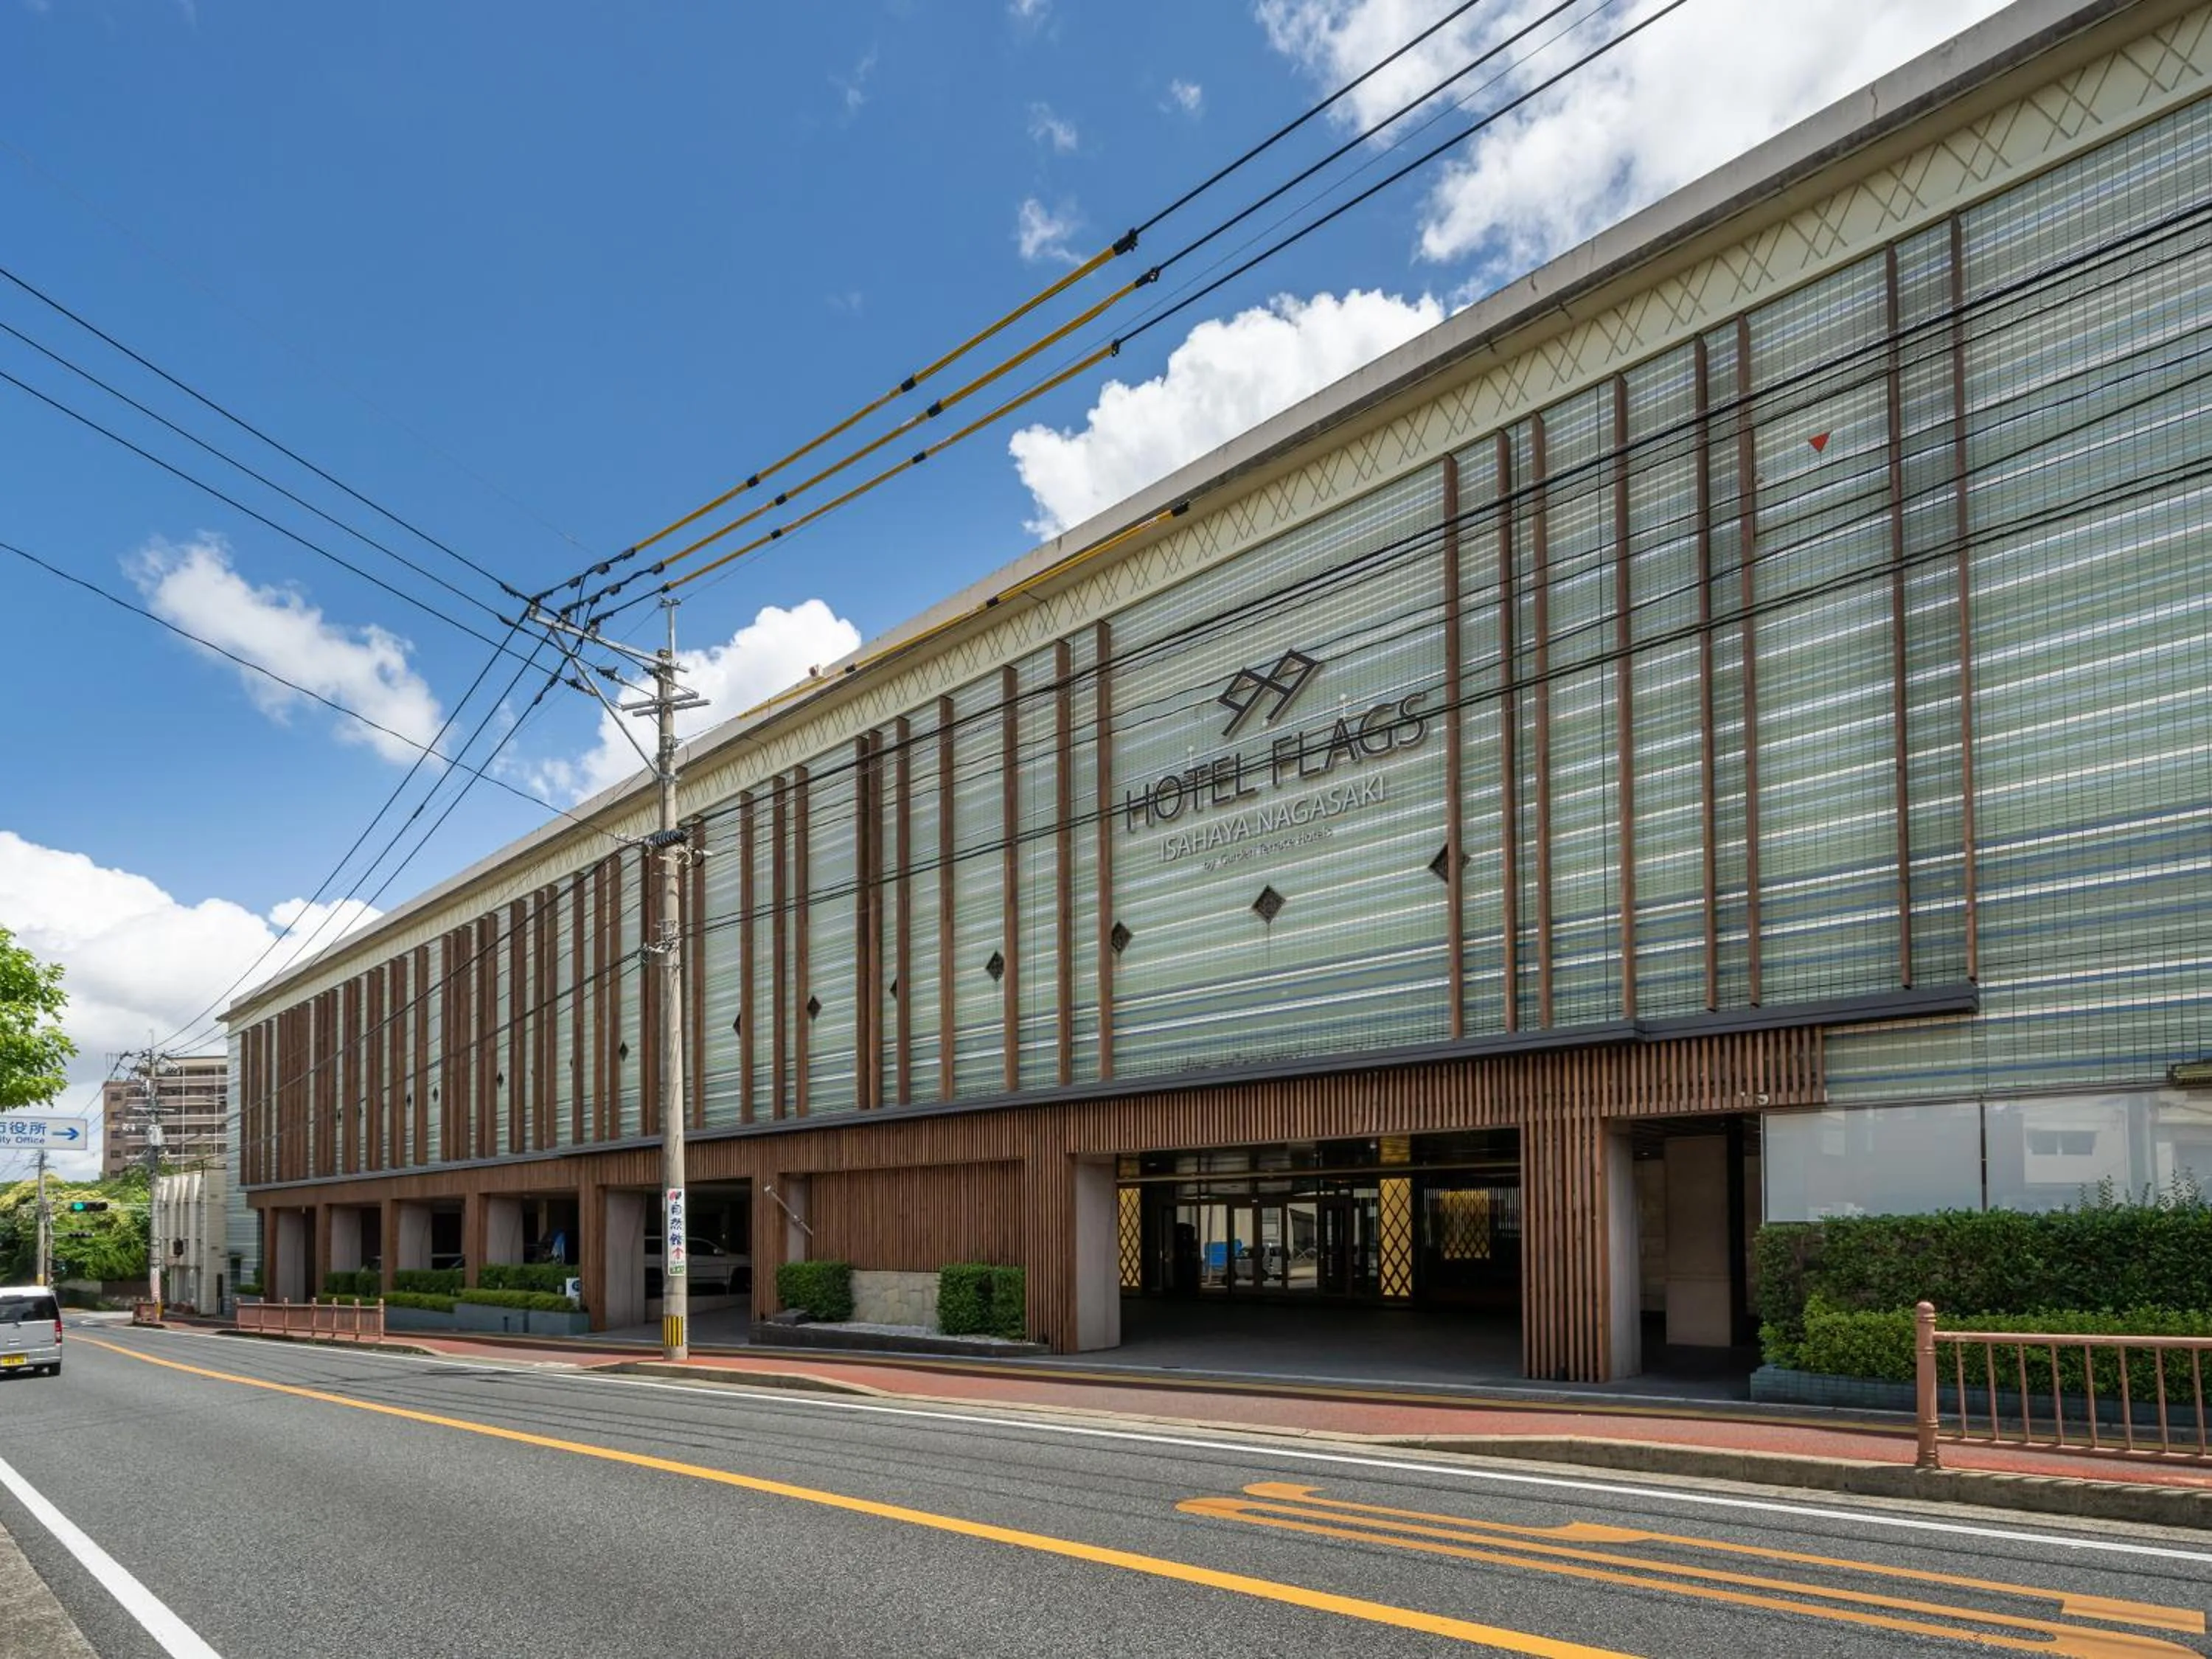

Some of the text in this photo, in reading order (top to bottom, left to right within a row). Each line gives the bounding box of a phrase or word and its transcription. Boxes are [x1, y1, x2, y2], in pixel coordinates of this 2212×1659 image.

[1126, 692, 1429, 832] HOTEL FLAGS
[1161, 775, 1386, 863] ISAHAYA NAGASAKI
